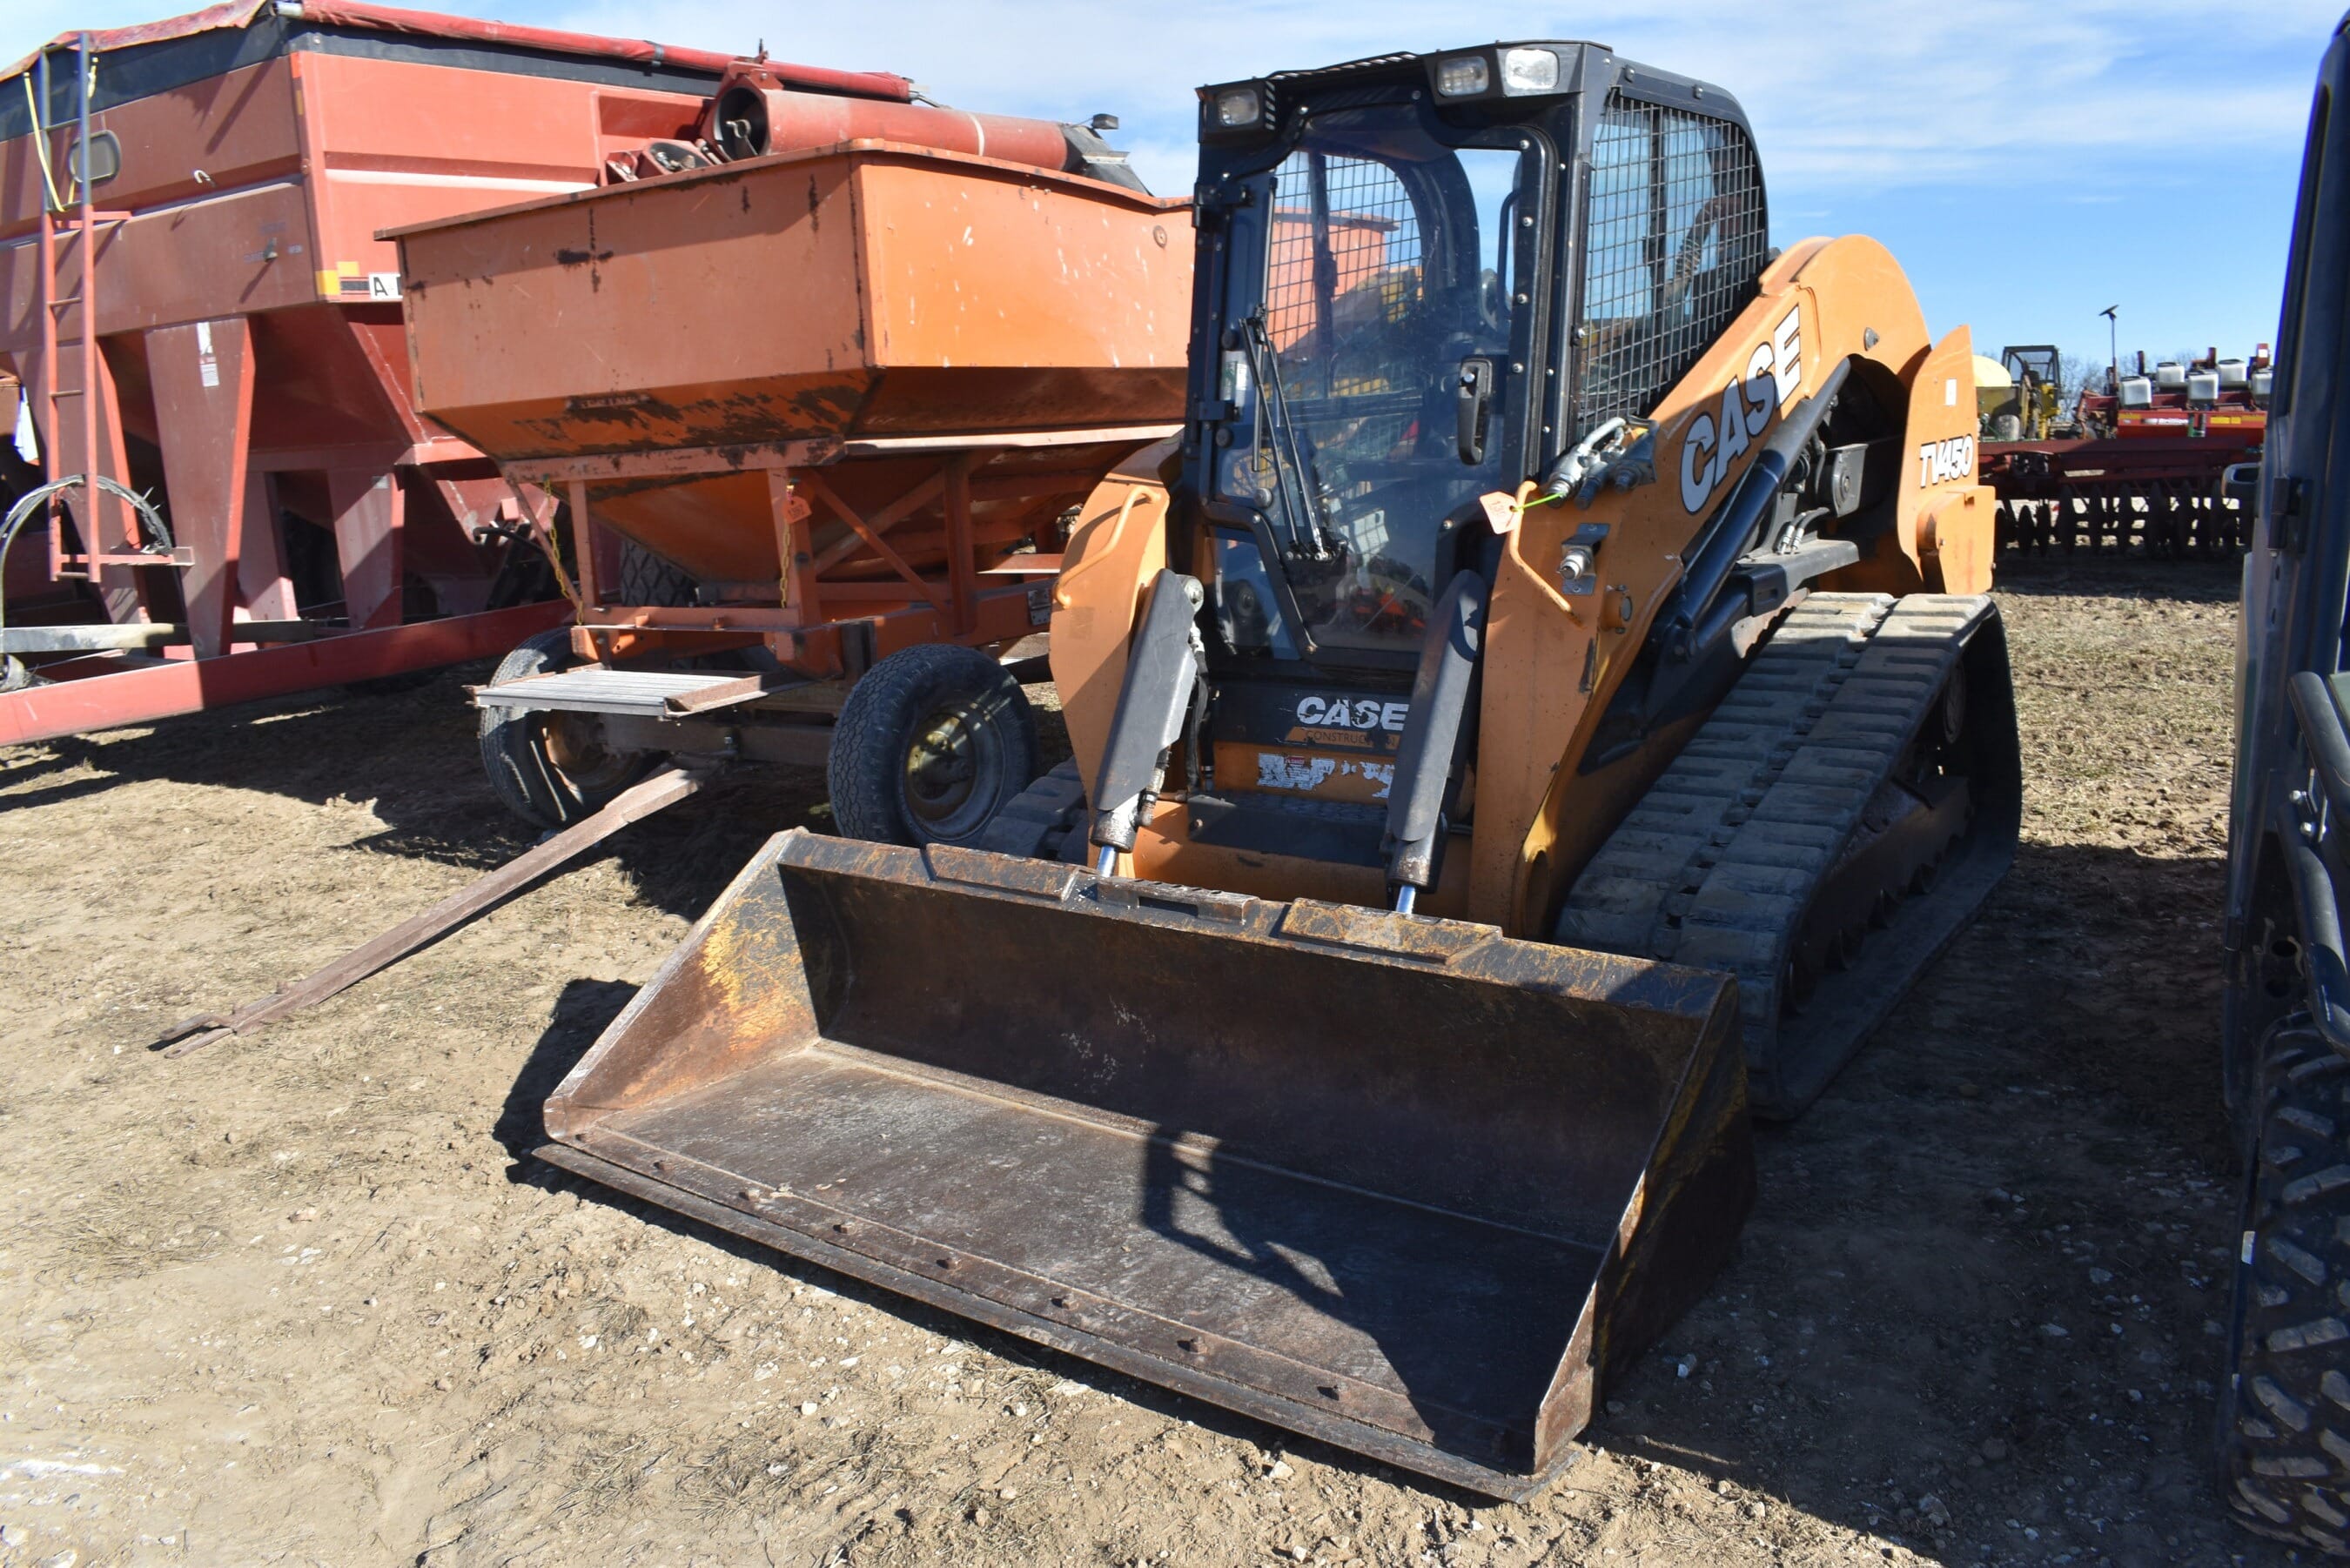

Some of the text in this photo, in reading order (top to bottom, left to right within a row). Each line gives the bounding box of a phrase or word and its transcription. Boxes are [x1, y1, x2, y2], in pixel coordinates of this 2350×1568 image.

[1681, 302, 1802, 515] CASE
[1919, 433, 1974, 489] TV450
[1297, 696, 1410, 731] CASE
